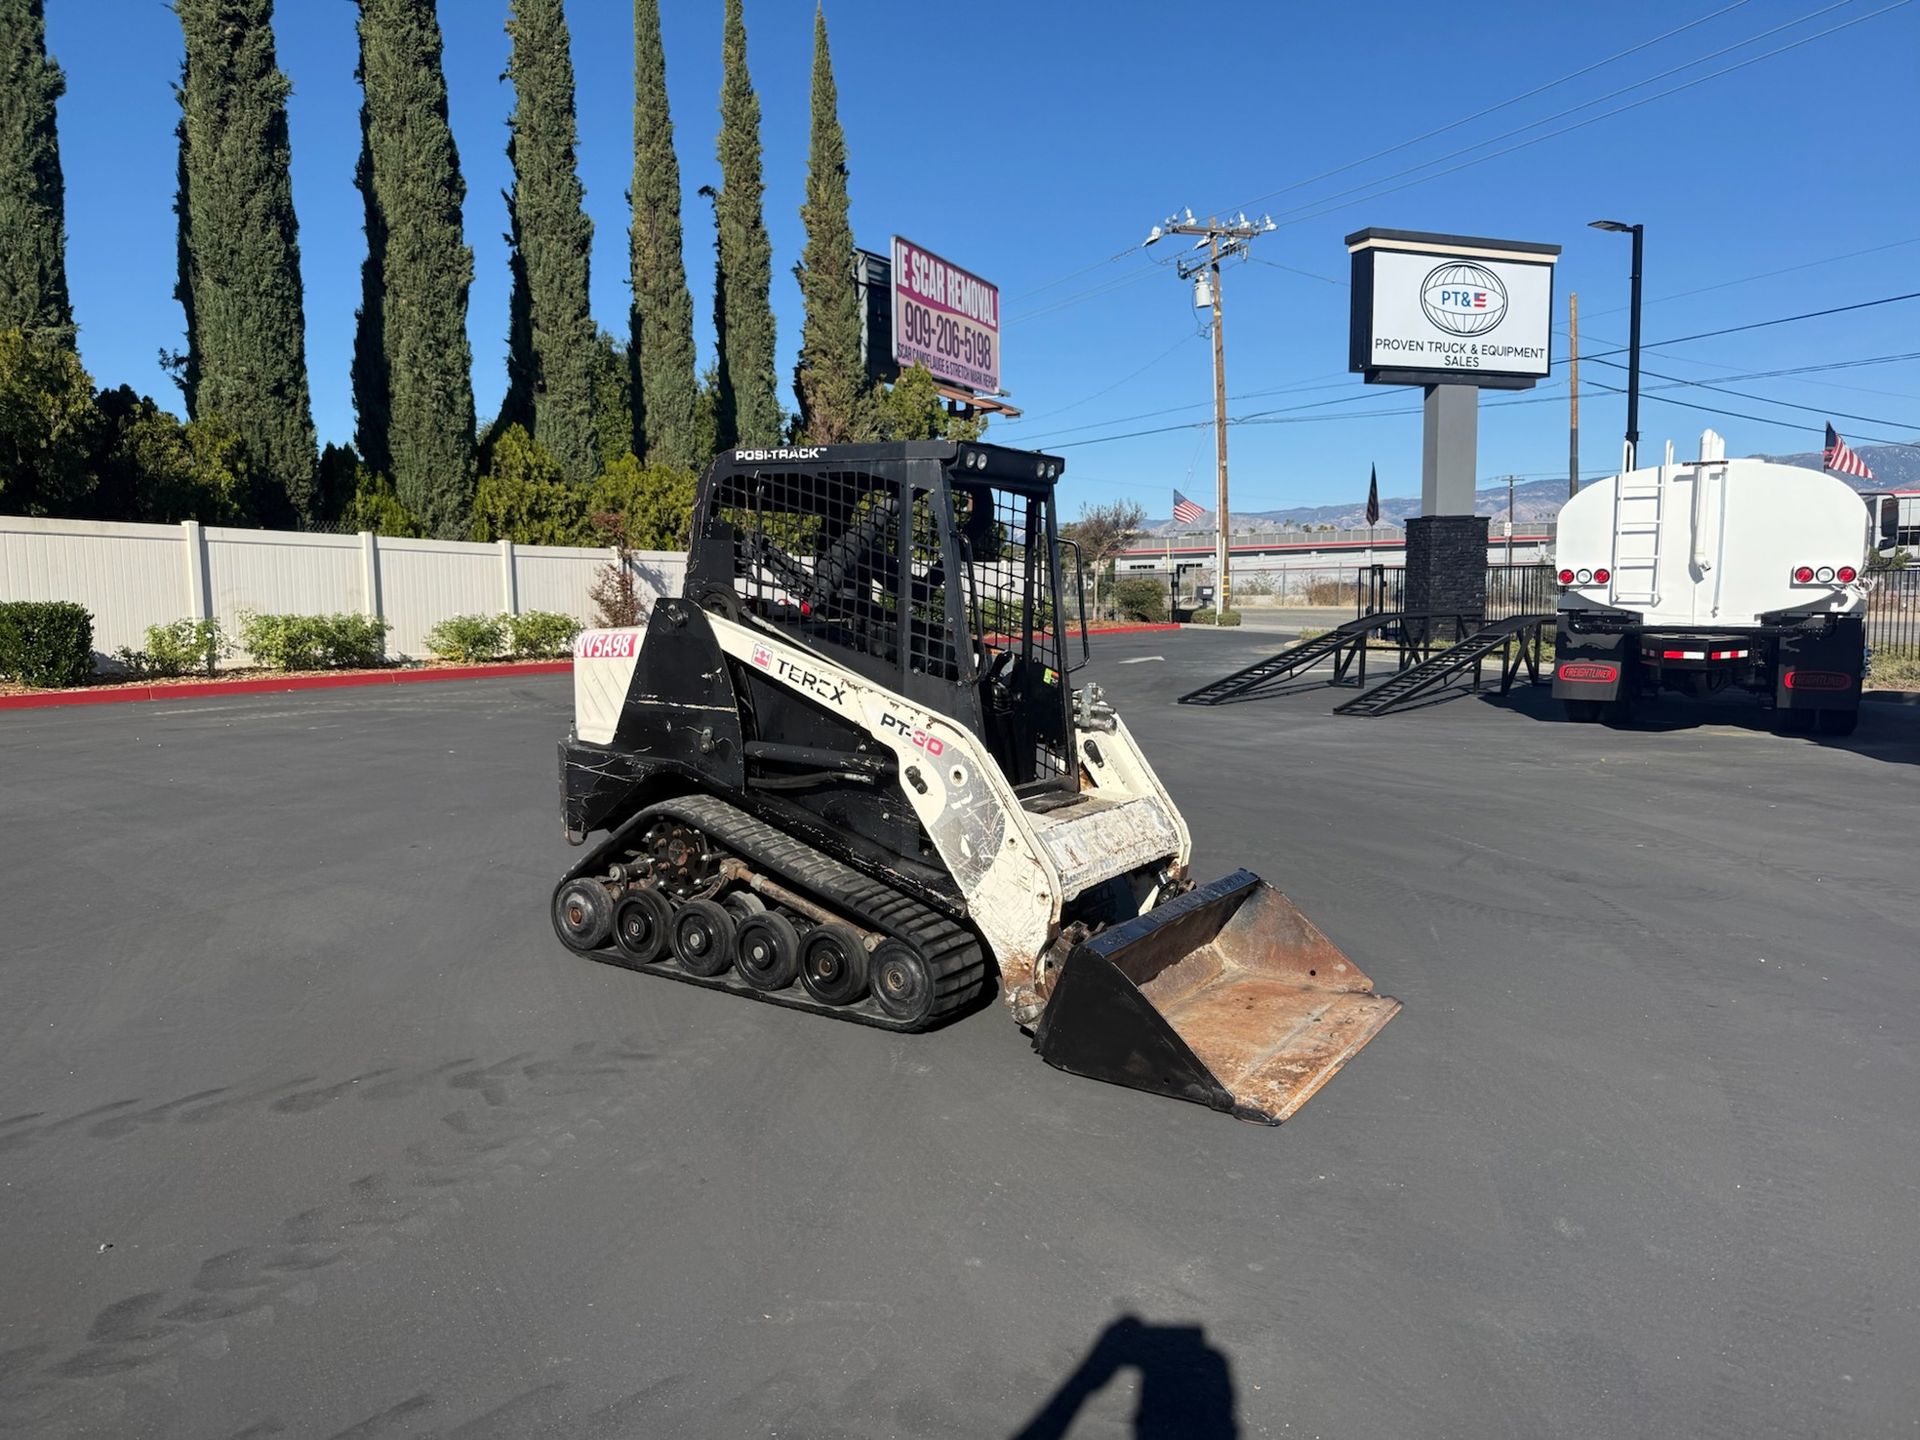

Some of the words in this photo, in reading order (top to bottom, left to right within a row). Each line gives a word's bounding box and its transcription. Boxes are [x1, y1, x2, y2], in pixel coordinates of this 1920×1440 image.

[897, 242, 909, 288] IE
[911, 251, 945, 305] SCAR
[948, 268, 997, 328] REMOVAL
[1441, 290, 1487, 308] PT&E
[905, 301, 992, 371] 909-206-5198
[897, 343, 912, 361] SCAR
[1375, 338, 1424, 352] PROVEN
[1427, 341, 1466, 354] TRUCK
[1471, 343, 1478, 355] &
[1481, 345, 1545, 359] EQUIPMENT
[1444, 355, 1480, 368] SALES
[777, 658, 846, 706] TEREX
[1565, 667, 1611, 679] FREIGHTLINER
[880, 712, 945, 757] PT-30
